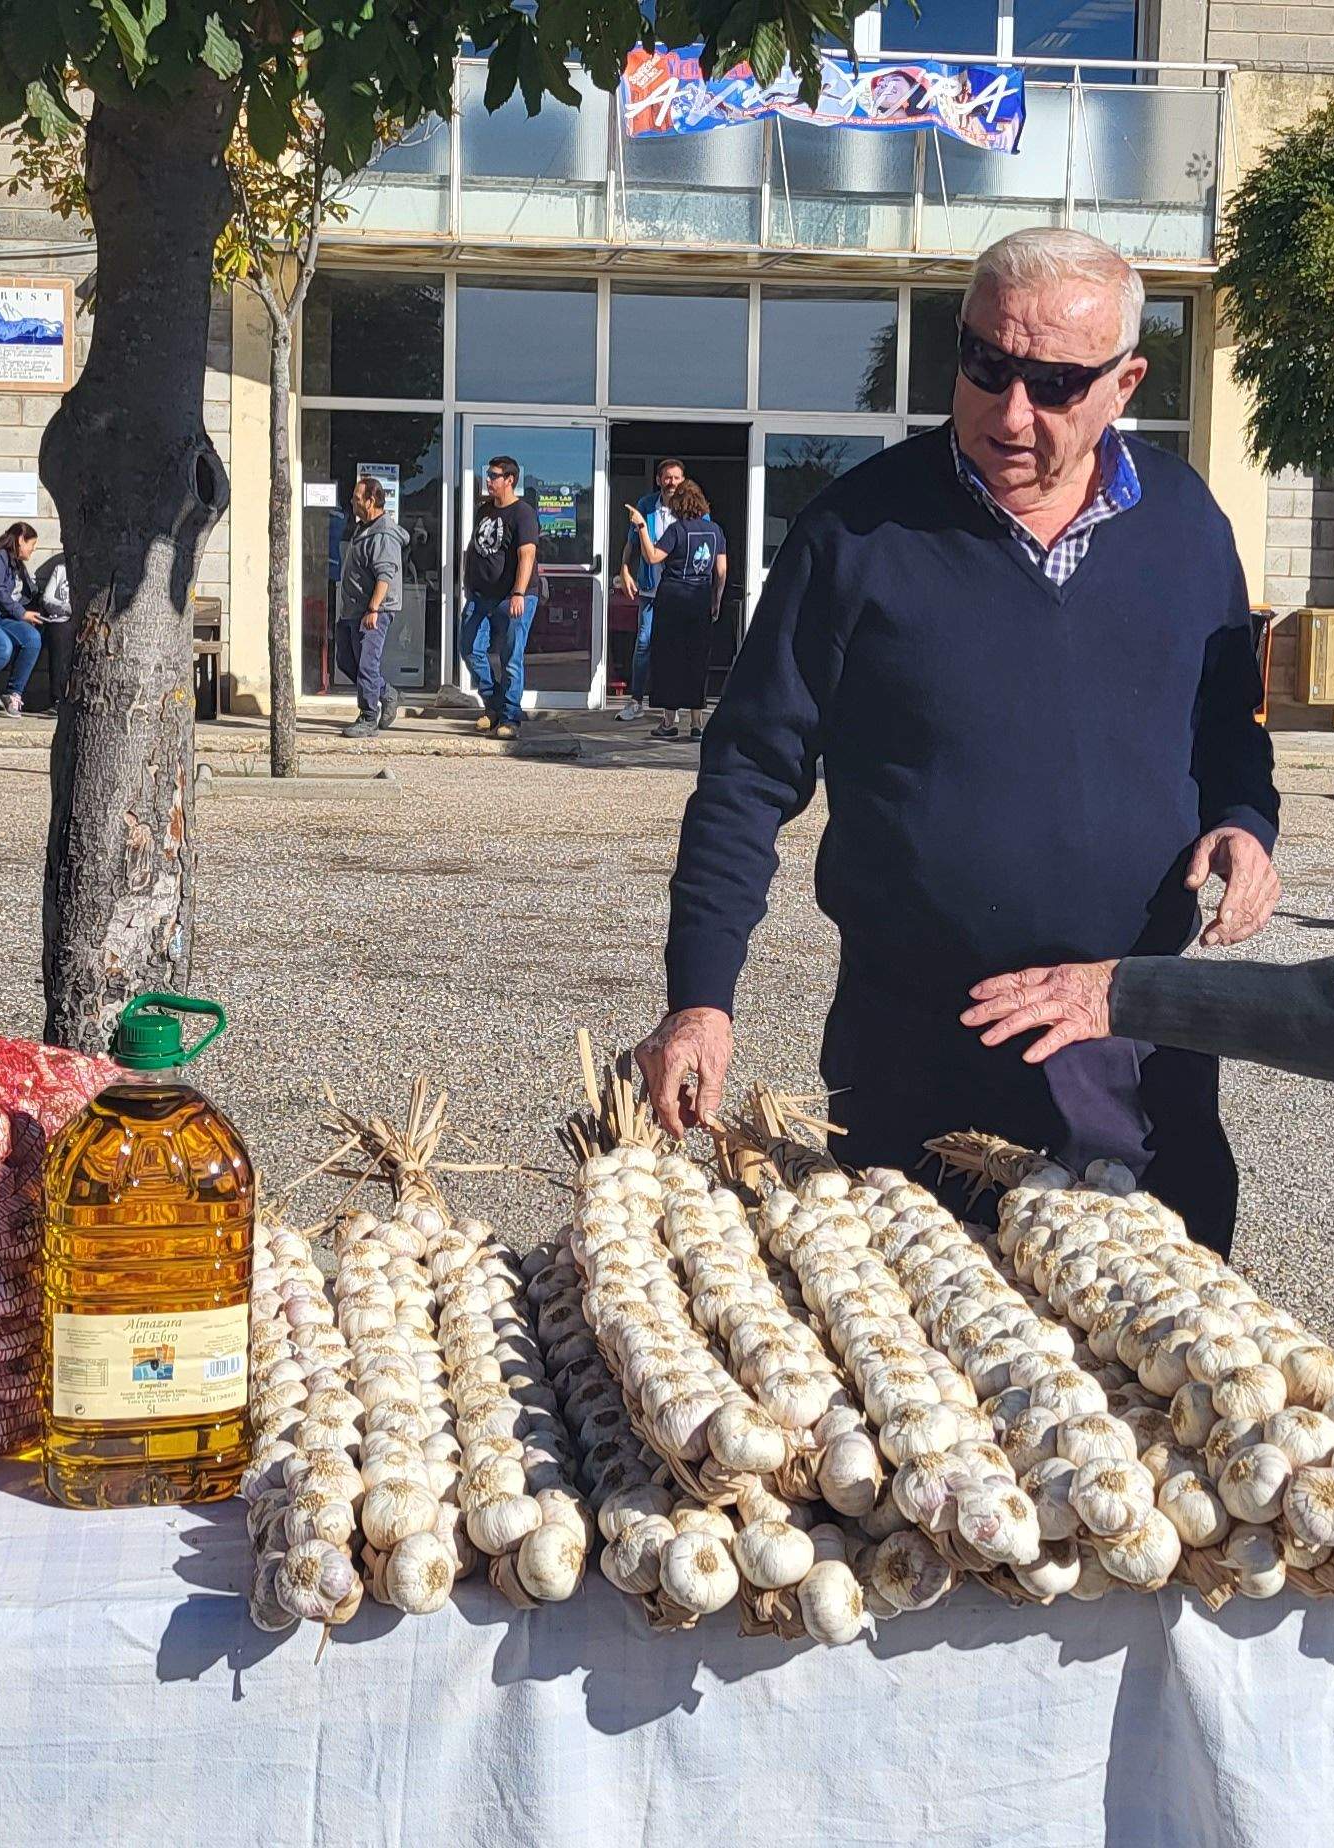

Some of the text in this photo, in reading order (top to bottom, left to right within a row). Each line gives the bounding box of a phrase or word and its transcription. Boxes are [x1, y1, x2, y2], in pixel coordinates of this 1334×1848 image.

[122, 1317, 183, 1331] Almazara
[128, 1330, 150, 1344] del
[149, 1328, 179, 1344] Ebro
